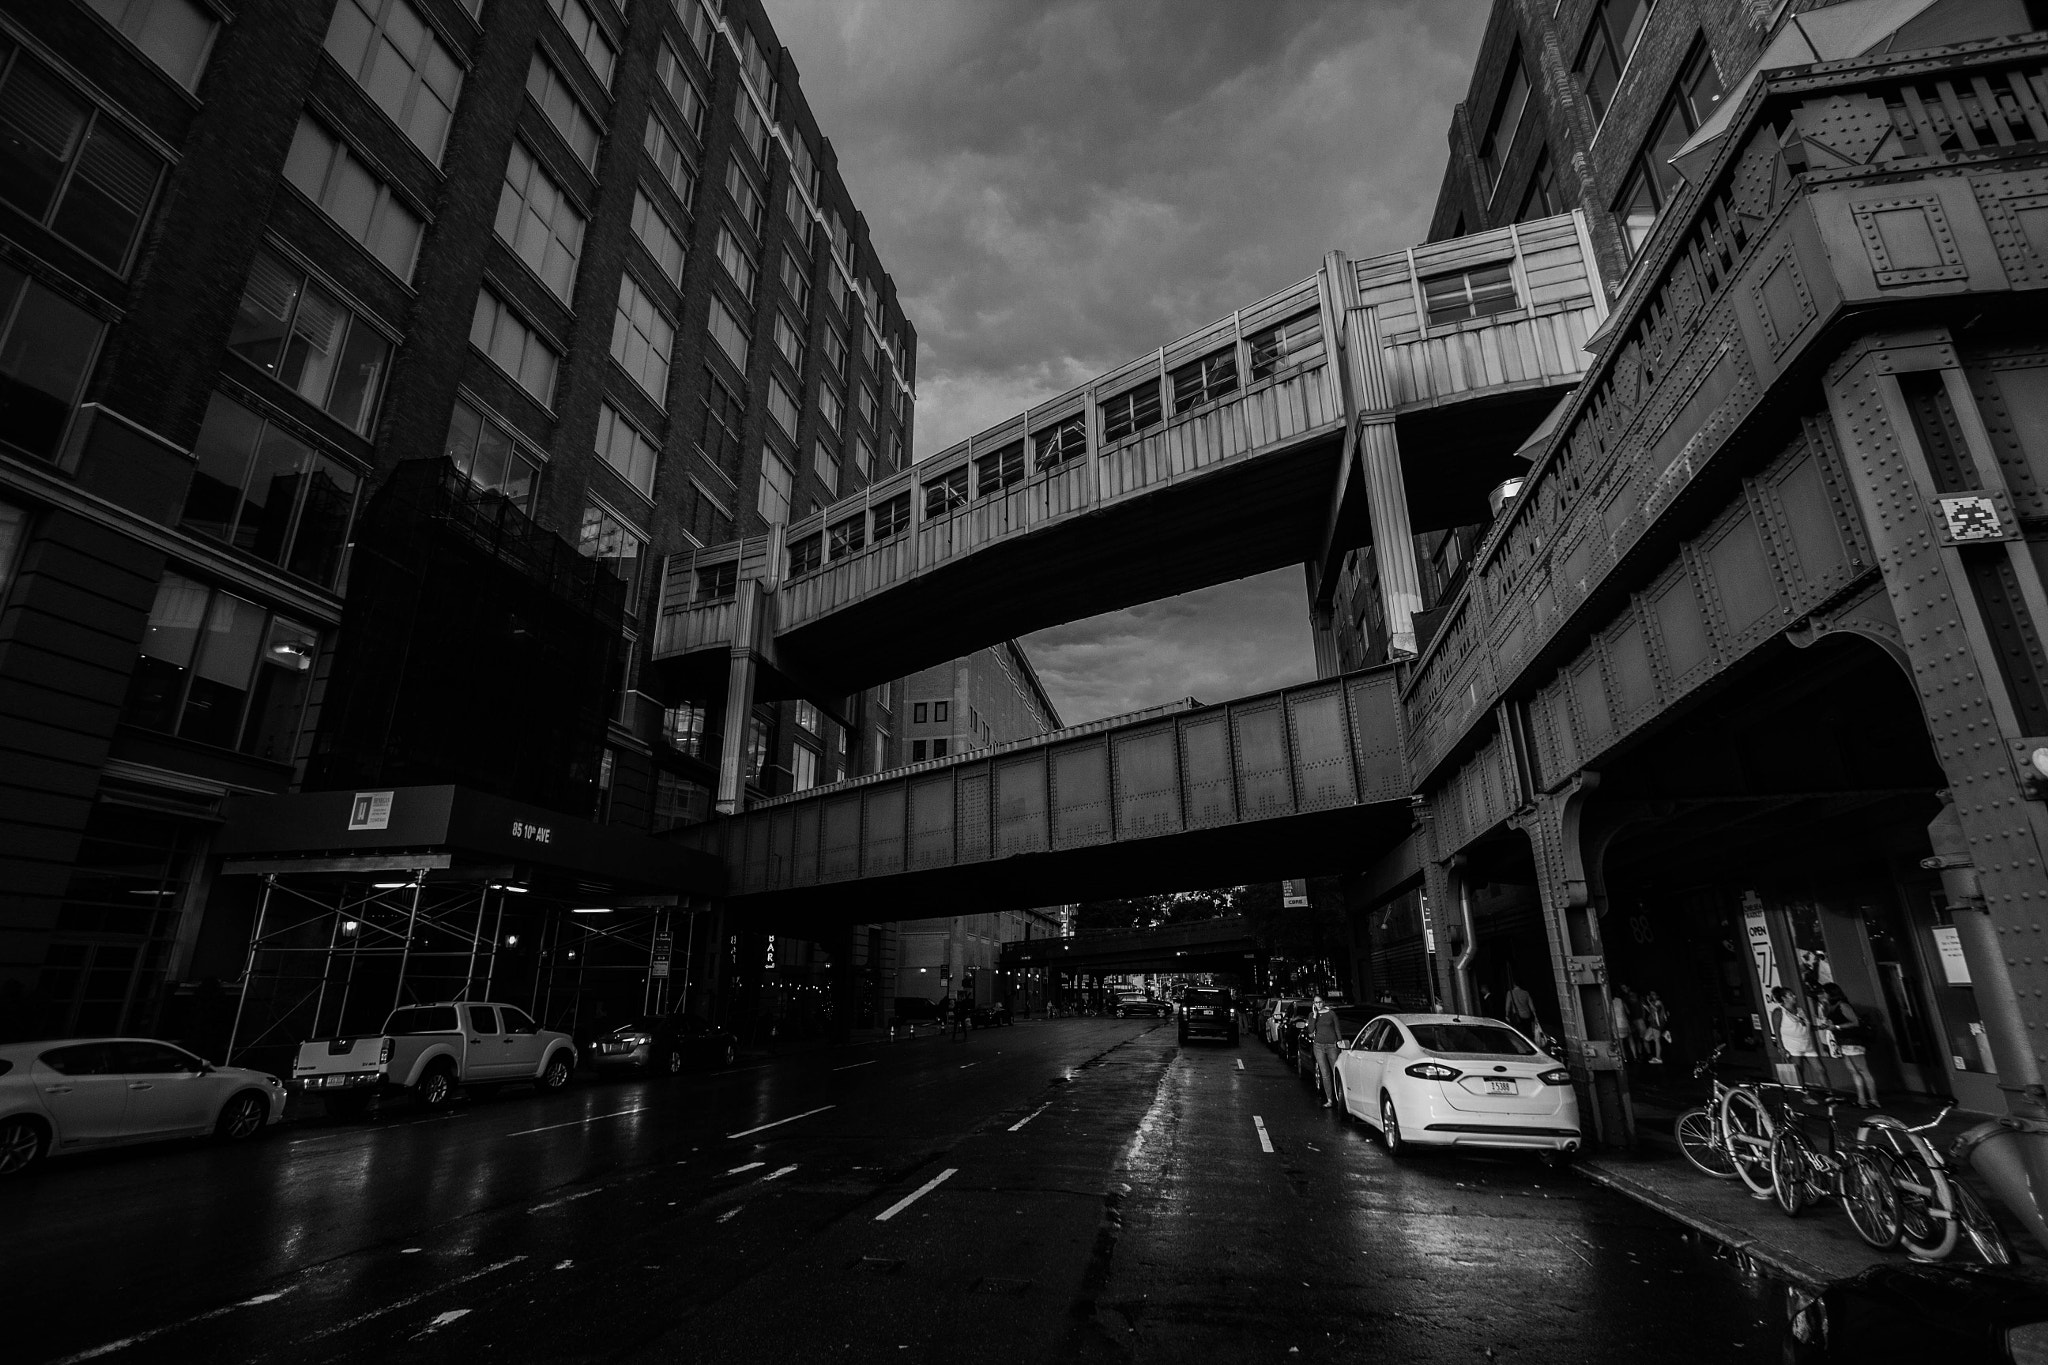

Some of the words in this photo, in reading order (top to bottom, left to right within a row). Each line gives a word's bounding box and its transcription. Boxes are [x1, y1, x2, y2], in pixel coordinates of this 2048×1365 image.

[512, 821, 523, 837] 85
[535, 826, 551, 844] AVE
[1629, 914, 1654, 944] 88
[1749, 926, 1767, 937] OPEN
[766, 934, 775, 962] BAR
[1752, 941, 1774, 988] 7
